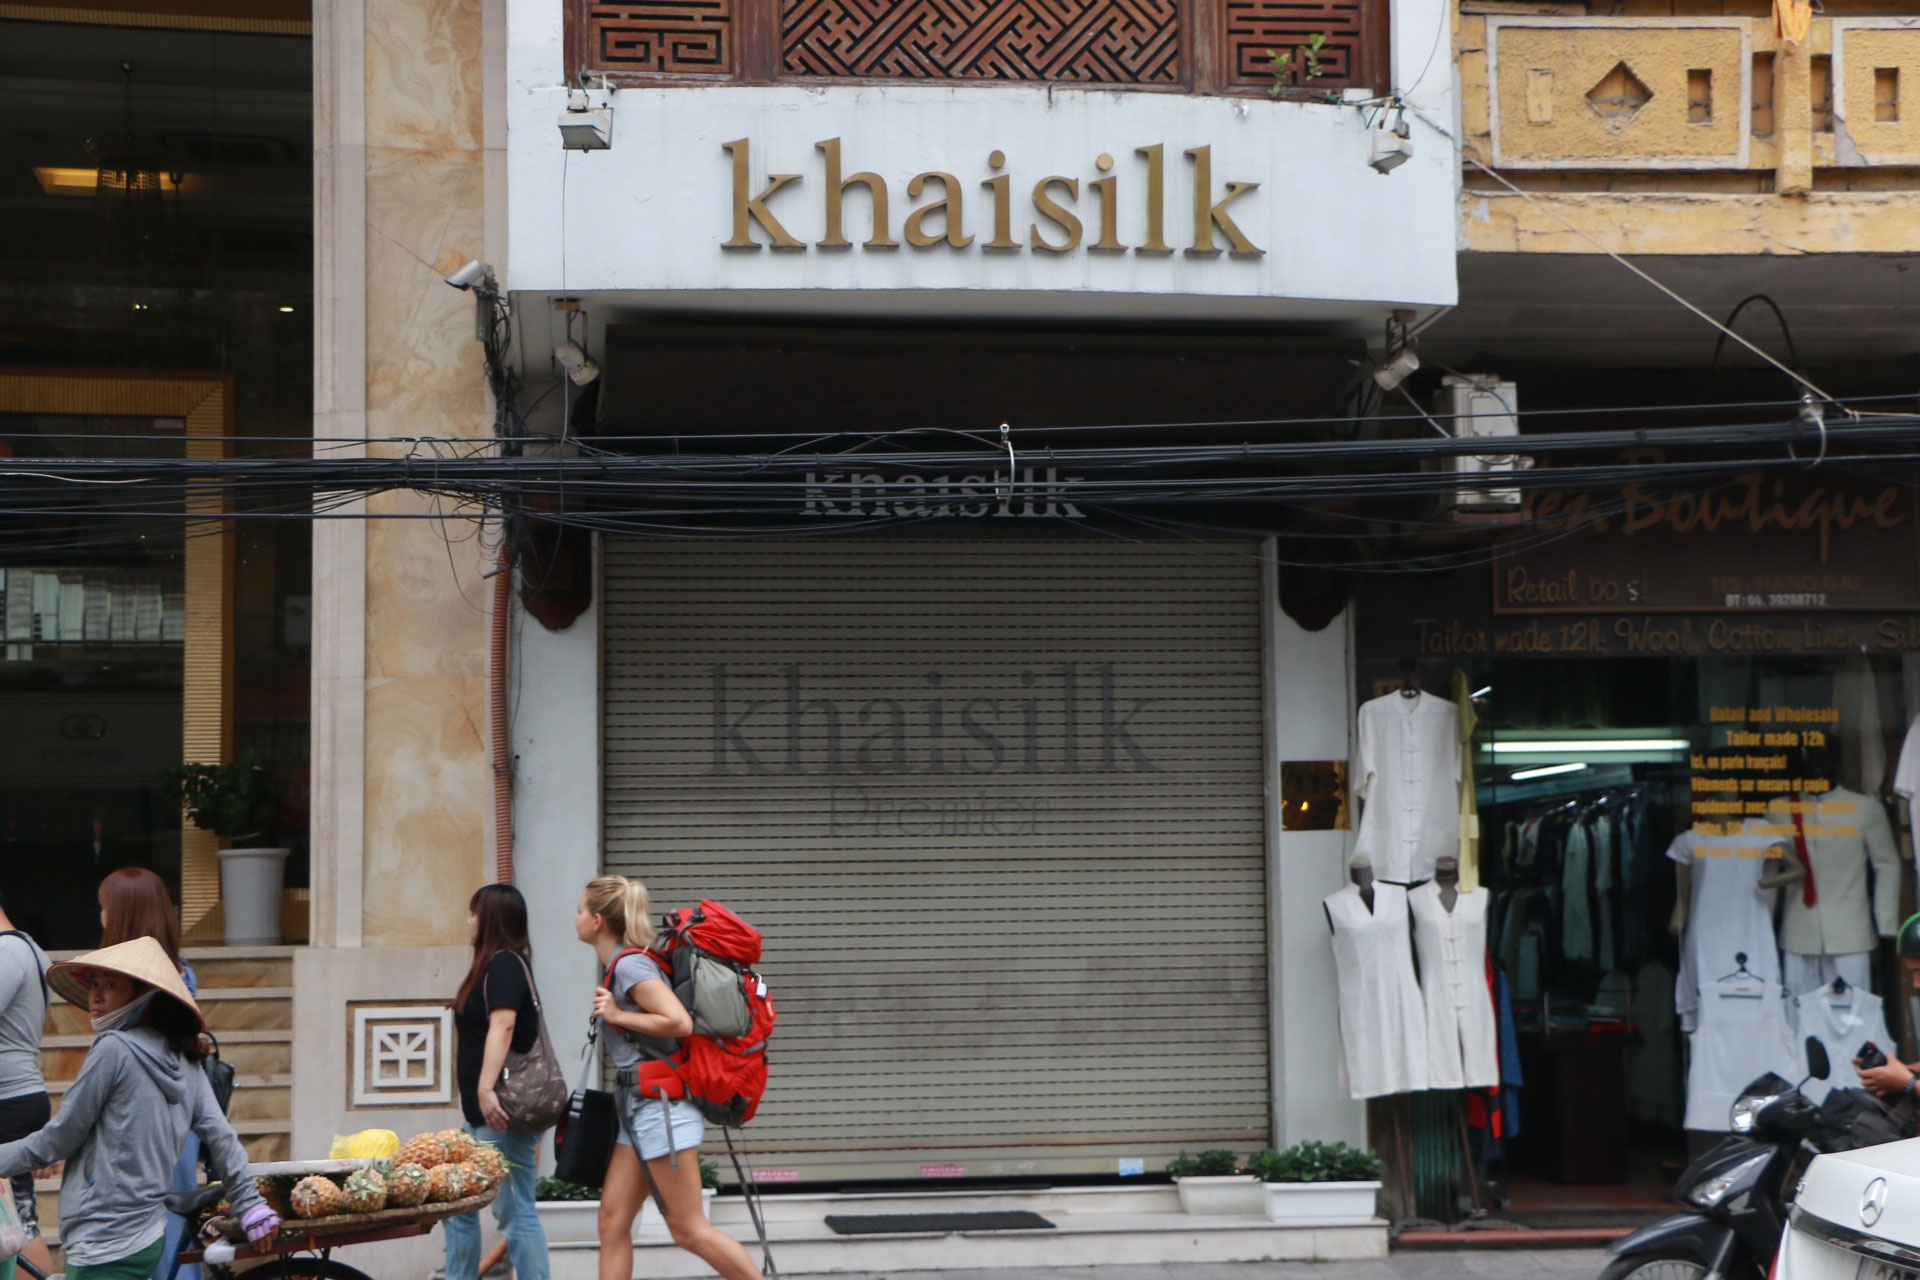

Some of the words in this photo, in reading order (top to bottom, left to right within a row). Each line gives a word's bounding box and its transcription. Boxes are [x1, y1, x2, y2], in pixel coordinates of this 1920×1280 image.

[720, 136, 1267, 256] khaisilk
[1507, 566, 1577, 605] Retail
[1413, 617, 1488, 654] Tailor
[1494, 619, 1552, 654] made
[703, 661, 1164, 775] khaisilk
[1709, 706, 1746, 722] Retail
[1748, 706, 1772, 722] and
[1775, 705, 1840, 722] Wholesale
[1726, 730, 1761, 747] Tailor
[1763, 730, 1799, 747] made
[1802, 730, 1826, 747] 12h
[827, 778, 1050, 838] Premier
